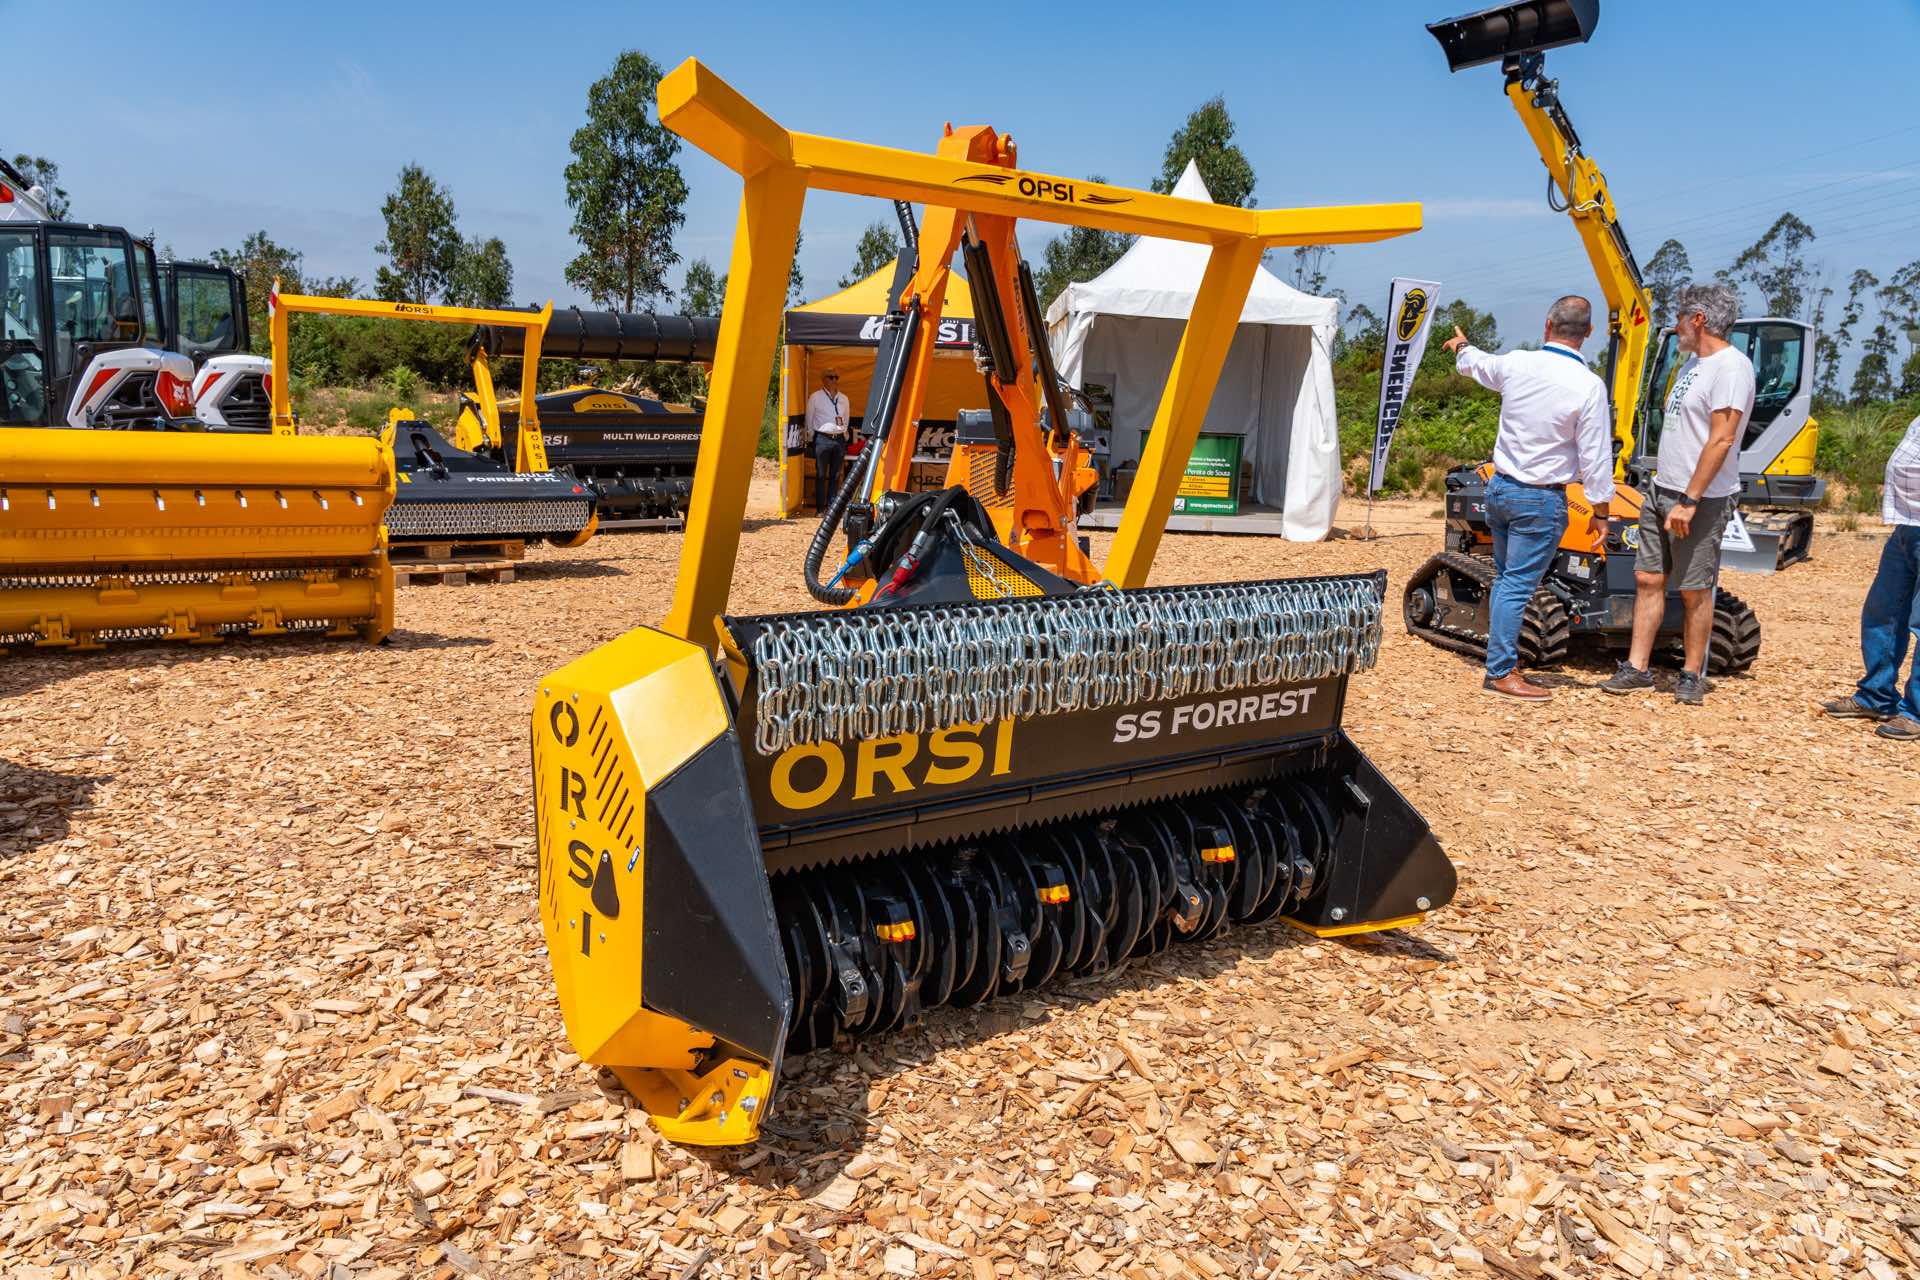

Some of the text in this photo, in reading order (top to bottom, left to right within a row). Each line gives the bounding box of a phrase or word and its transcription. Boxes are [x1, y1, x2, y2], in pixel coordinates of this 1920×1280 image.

[937, 321, 971, 343] SI
[530, 433, 544, 470] ORSI
[542, 434, 569, 447] RSI
[602, 432, 633, 441] MULTI
[635, 432, 661, 441] WILD
[1112, 686, 1318, 743] SS FORREST
[769, 714, 1016, 810] ORSI
[549, 700, 595, 958] ORSI
